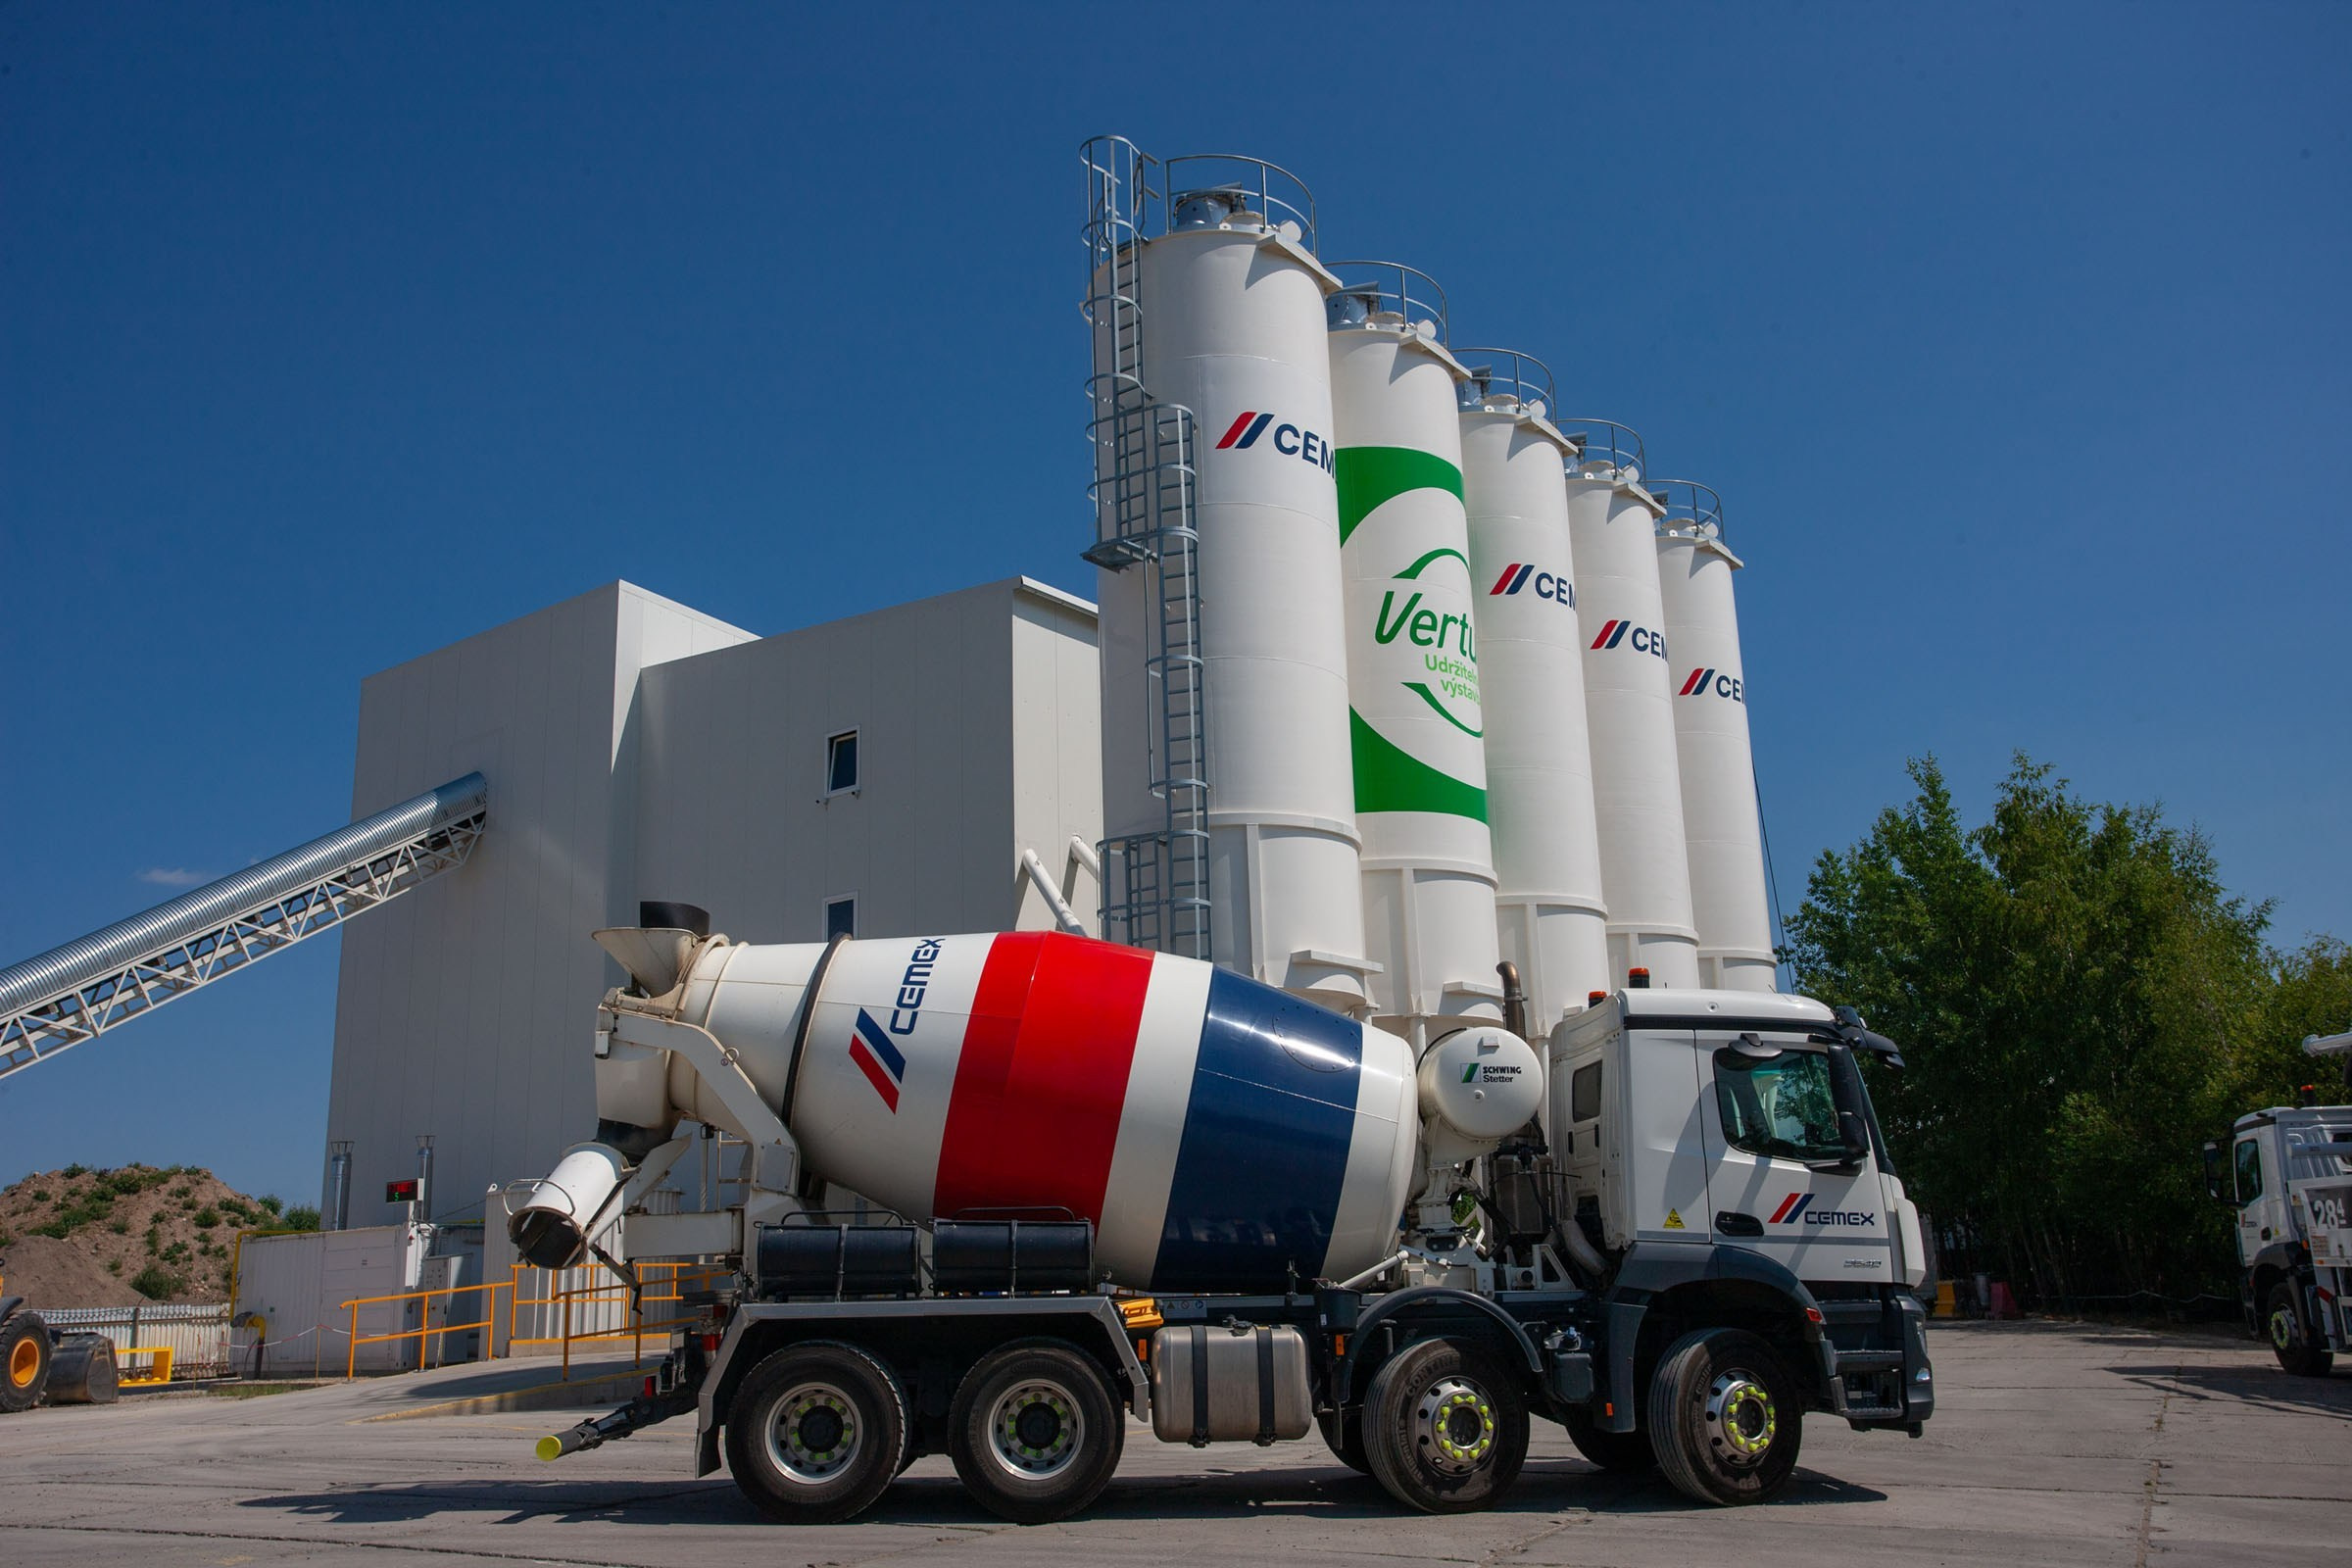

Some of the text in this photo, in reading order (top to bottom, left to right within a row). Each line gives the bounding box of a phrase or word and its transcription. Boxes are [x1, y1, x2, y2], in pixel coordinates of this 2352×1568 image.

[1274, 423, 1334, 479] CEM
[1375, 591, 1476, 664] Vertu
[889, 938, 946, 1035] CEMEX
[1483, 1065, 1522, 1074] SCHWING
[1483, 1074, 1514, 1083] Stetter
[1804, 1210, 1875, 1226] CEMEX
